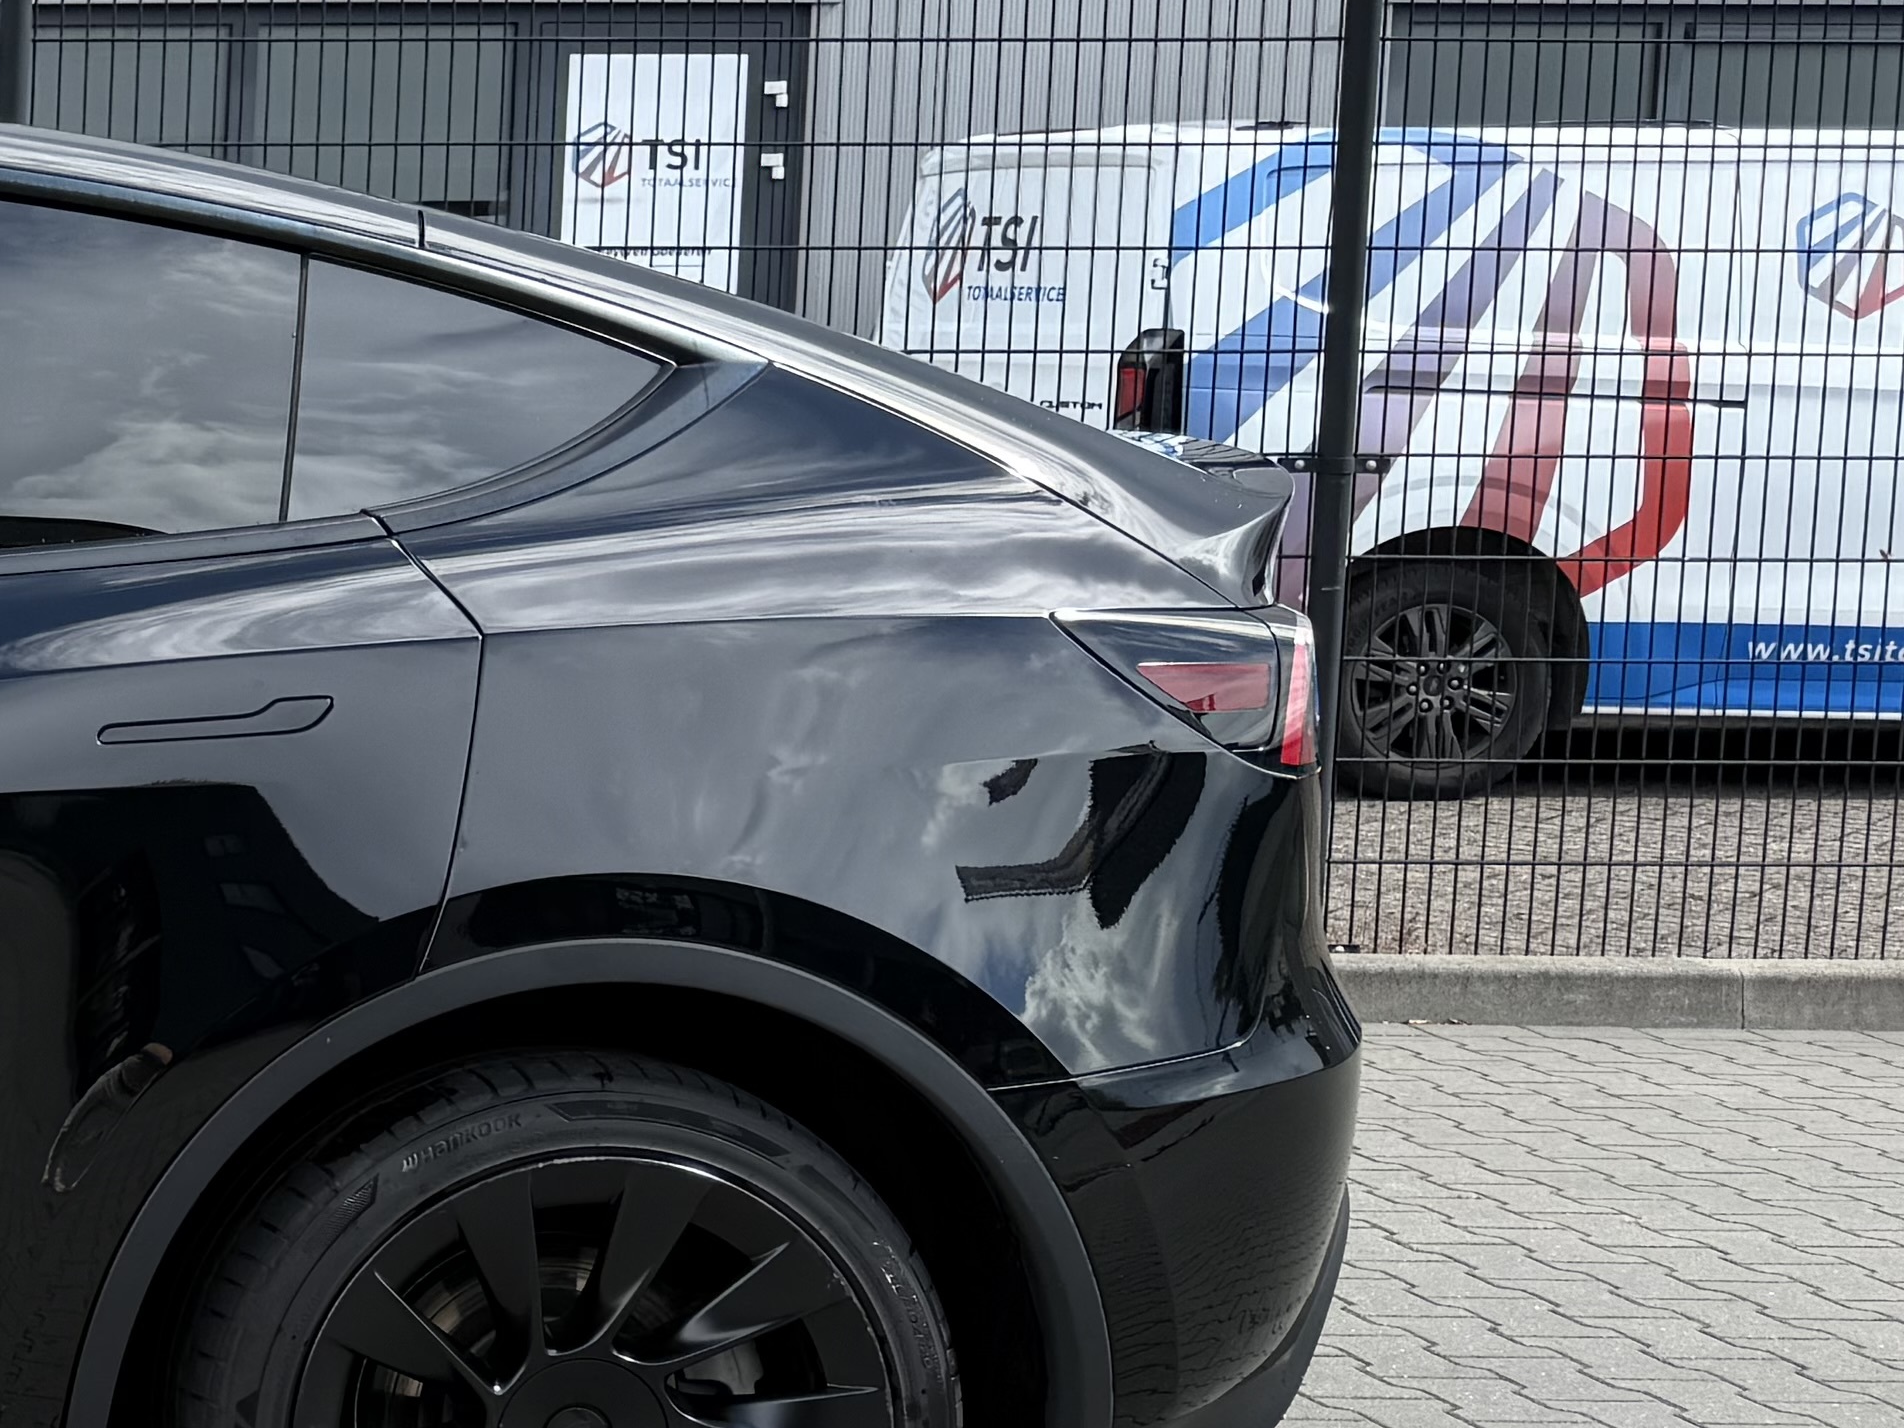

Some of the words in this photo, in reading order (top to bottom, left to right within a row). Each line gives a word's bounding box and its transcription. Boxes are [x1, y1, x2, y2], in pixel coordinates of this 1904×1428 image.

[642, 138, 701, 171] TSI
[641, 177, 739, 188] TOTAALSEVIC
[977, 215, 1039, 272] TSI
